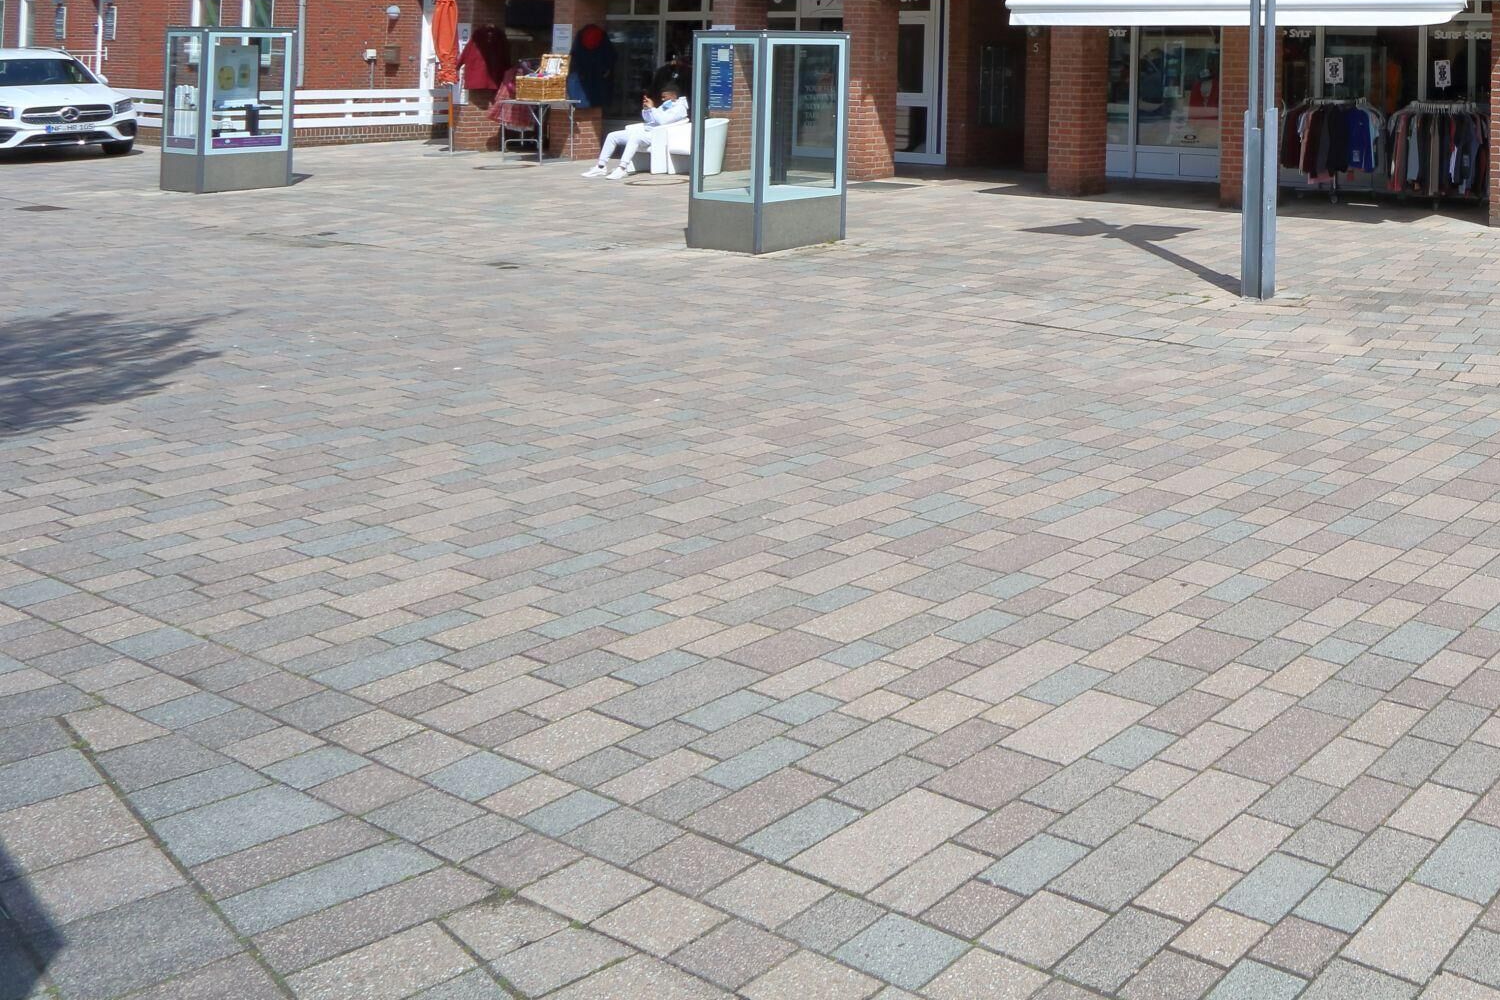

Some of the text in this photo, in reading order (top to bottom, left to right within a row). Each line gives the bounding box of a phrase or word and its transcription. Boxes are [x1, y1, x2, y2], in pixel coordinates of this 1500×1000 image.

[1108, 28, 1128, 38] SYLT
[1289, 28, 1313, 38] SYLT
[1434, 30, 1462, 40] SURF
[1032, 43, 1040, 53] 5
